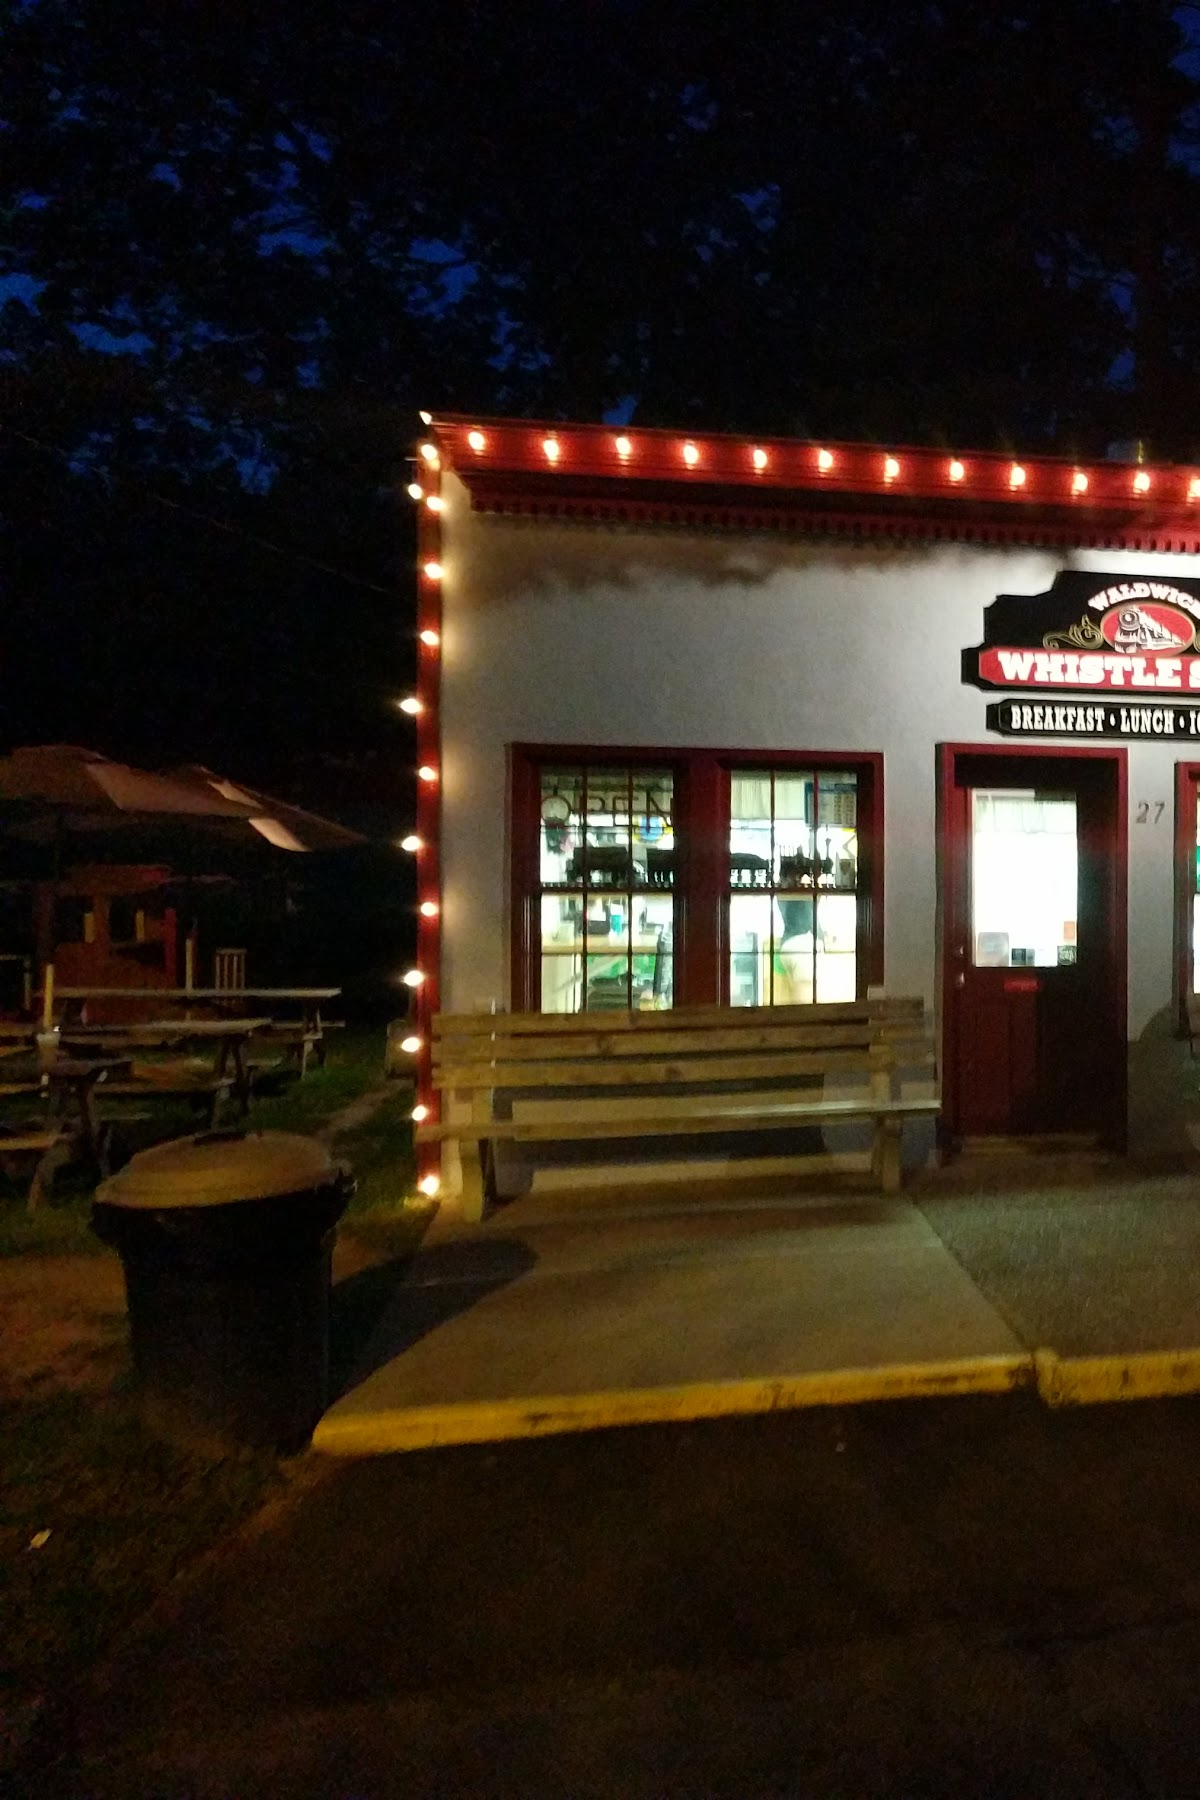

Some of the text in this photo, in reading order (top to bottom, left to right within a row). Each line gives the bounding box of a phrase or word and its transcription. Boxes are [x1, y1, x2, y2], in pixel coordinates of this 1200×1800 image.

[997, 651, 1182, 687] WHISTLE
[1010, 705, 1105, 731] BREAKFAST
[1120, 708, 1175, 734] LUNCH
[1136, 801, 1165, 824] 27
